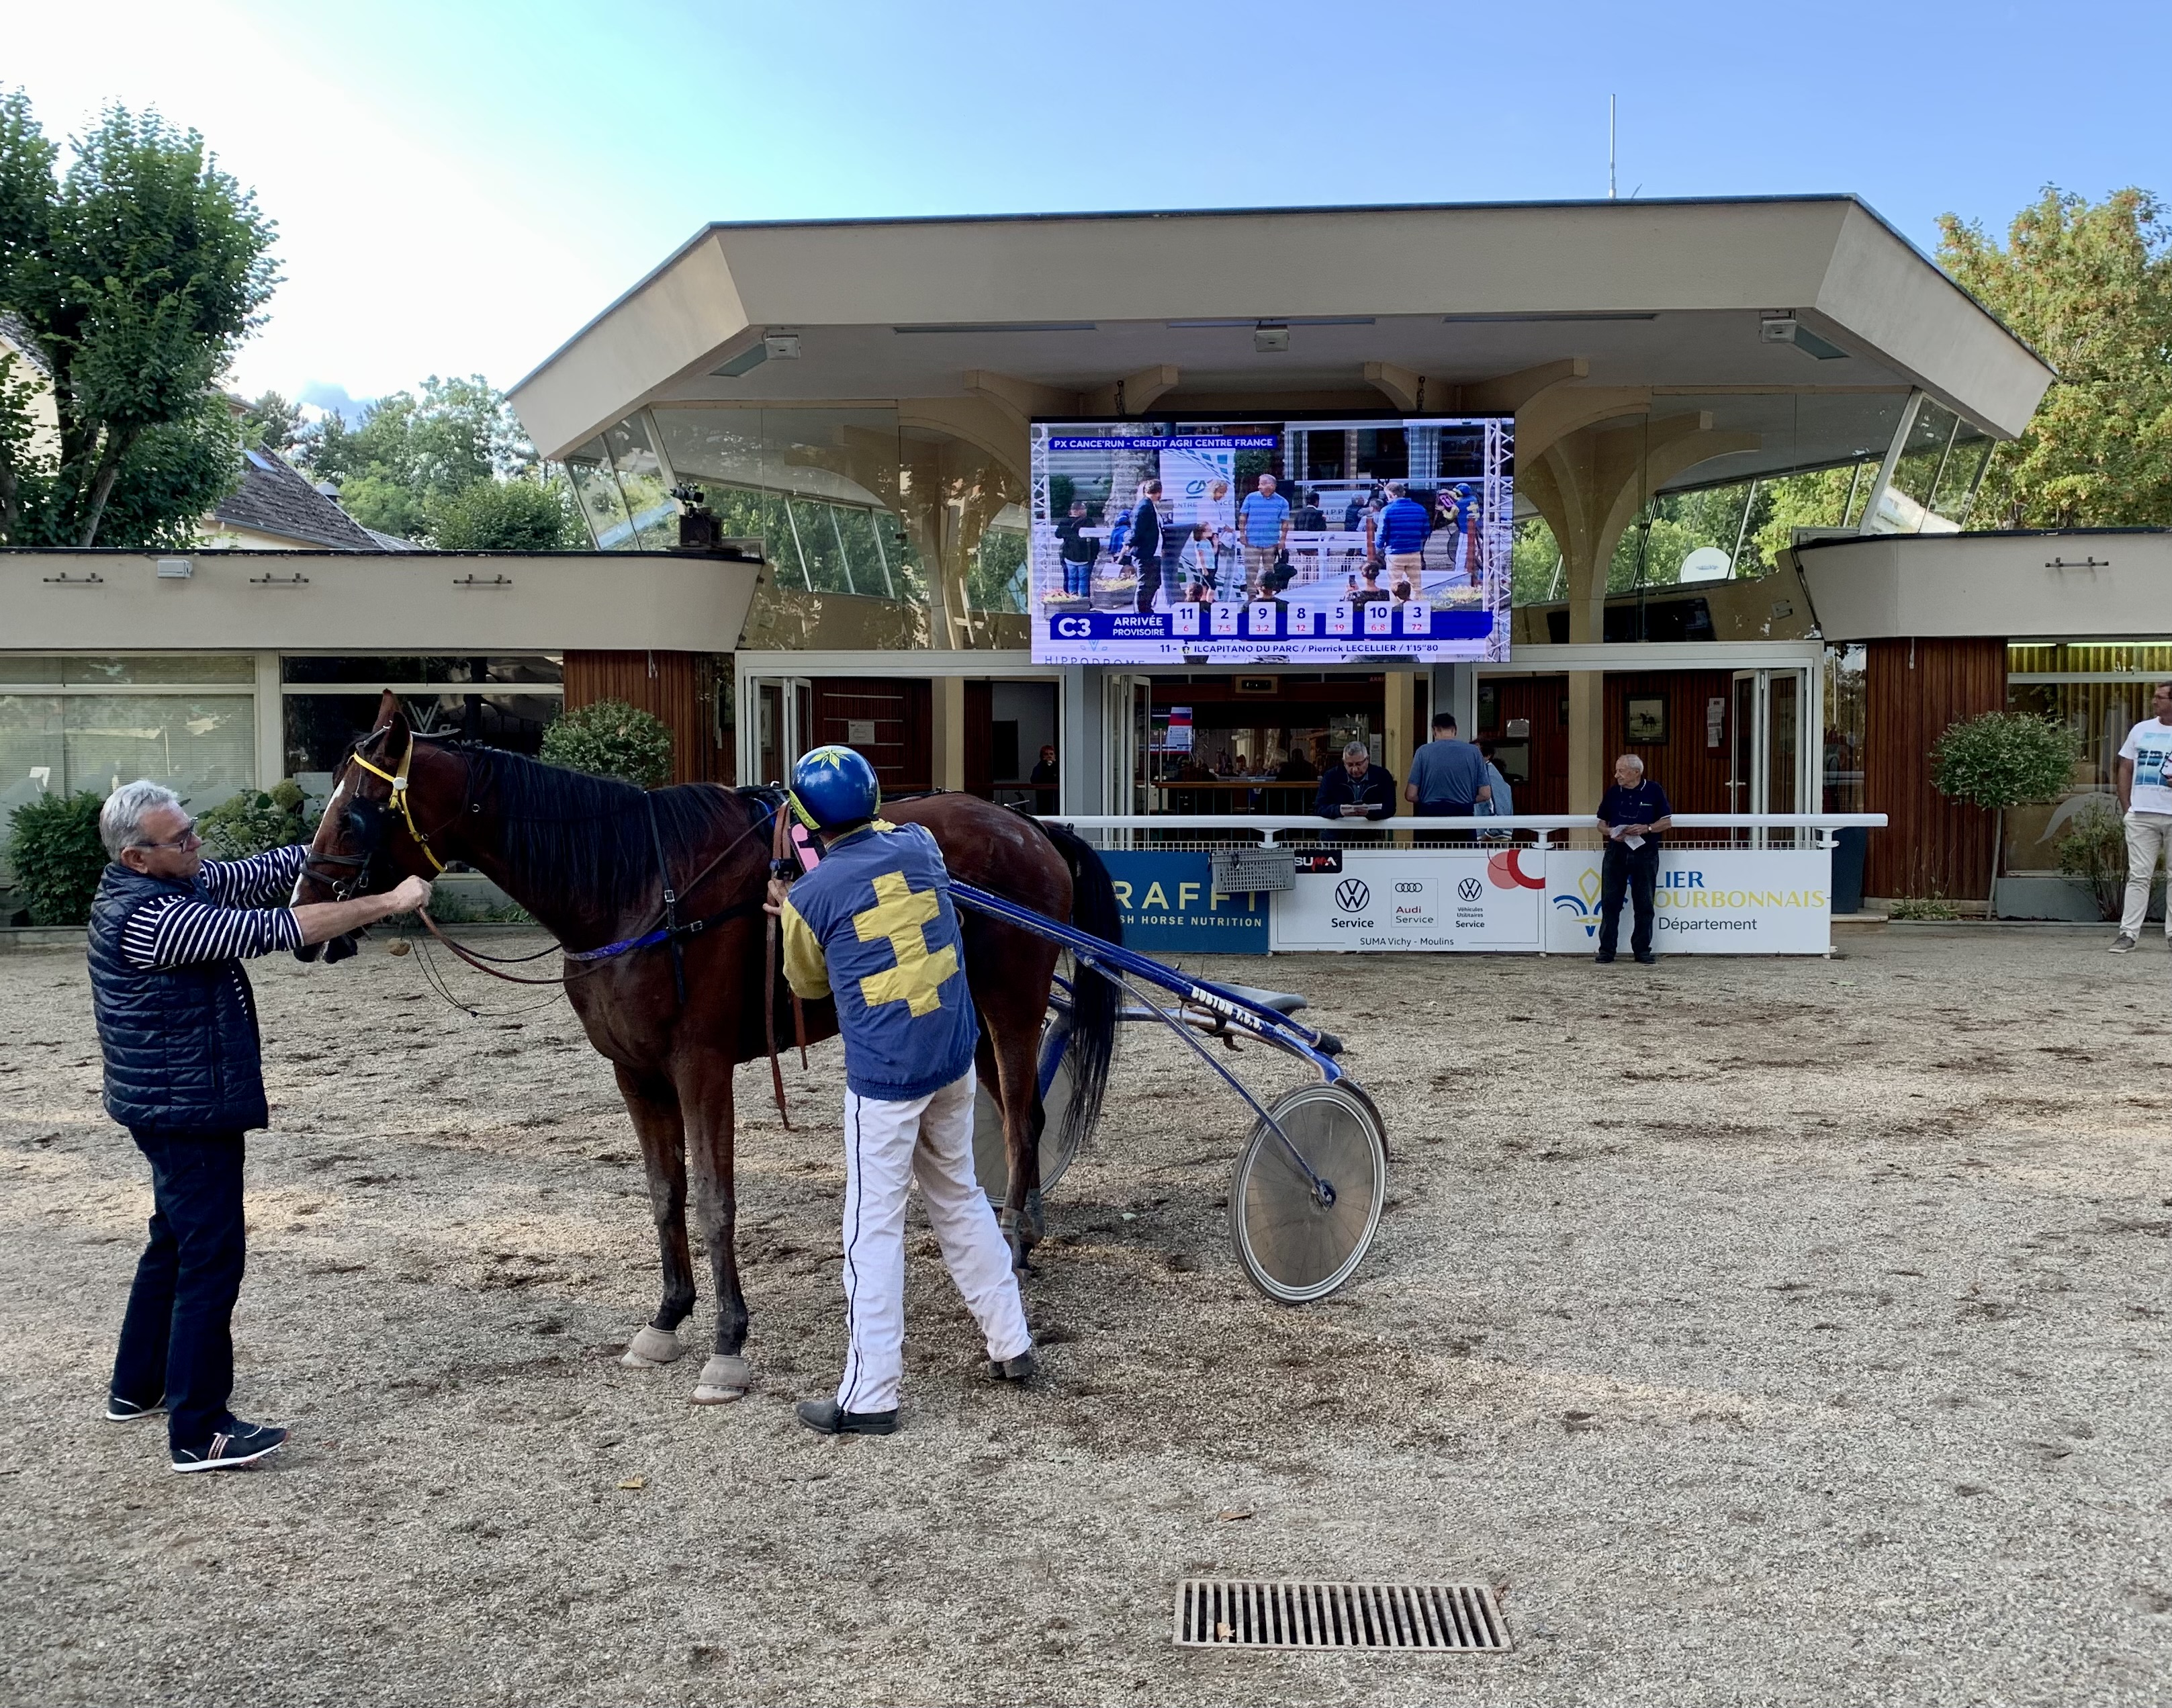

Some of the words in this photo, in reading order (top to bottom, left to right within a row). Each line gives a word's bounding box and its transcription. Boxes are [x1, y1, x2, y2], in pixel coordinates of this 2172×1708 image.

[1054, 440, 1069, 448] PX
[1133, 439, 1167, 447] CREDIT
[1169, 439, 1193, 447] AGRI
[1195, 439, 1233, 447] CENTRE
[1234, 438, 1273, 447] FRANCE
[1179, 608, 1193, 619] 11
[1220, 608, 1229, 619] 2
[1258, 607, 1267, 619] 9
[1296, 607, 1306, 619] 8
[1335, 607, 1345, 619] 5
[1369, 606, 1388, 619] 10
[1413, 606, 1422, 618] 3
[1114, 615, 1163, 627] ARRIVÉE
[1058, 617, 1091, 637] C3
[1112, 628, 1165, 636] PROVISOIRE
[1371, 623, 1386, 631] 6.8
[1411, 623, 1422, 631] 72
[1160, 644, 1170, 652] 11
[1308, 644, 1343, 652] Pierrick
[1346, 644, 1396, 652] LECELLIER
[1654, 890, 1825, 908] OURBONNAIS
[1142, 915, 1184, 926] HORSE
[1191, 916, 1262, 927] NUTRITION
[1331, 917, 1374, 928] Service
[1396, 915, 1434, 924] Service
[1456, 920, 1485, 928] Service
[1659, 917, 1758, 934] Département
[1360, 938, 1386, 946] SUMA
[1388, 937, 1411, 947] Vichy
[1420, 937, 1454, 946] Moulins
[1191, 985, 1234, 1016] CUSTOM
